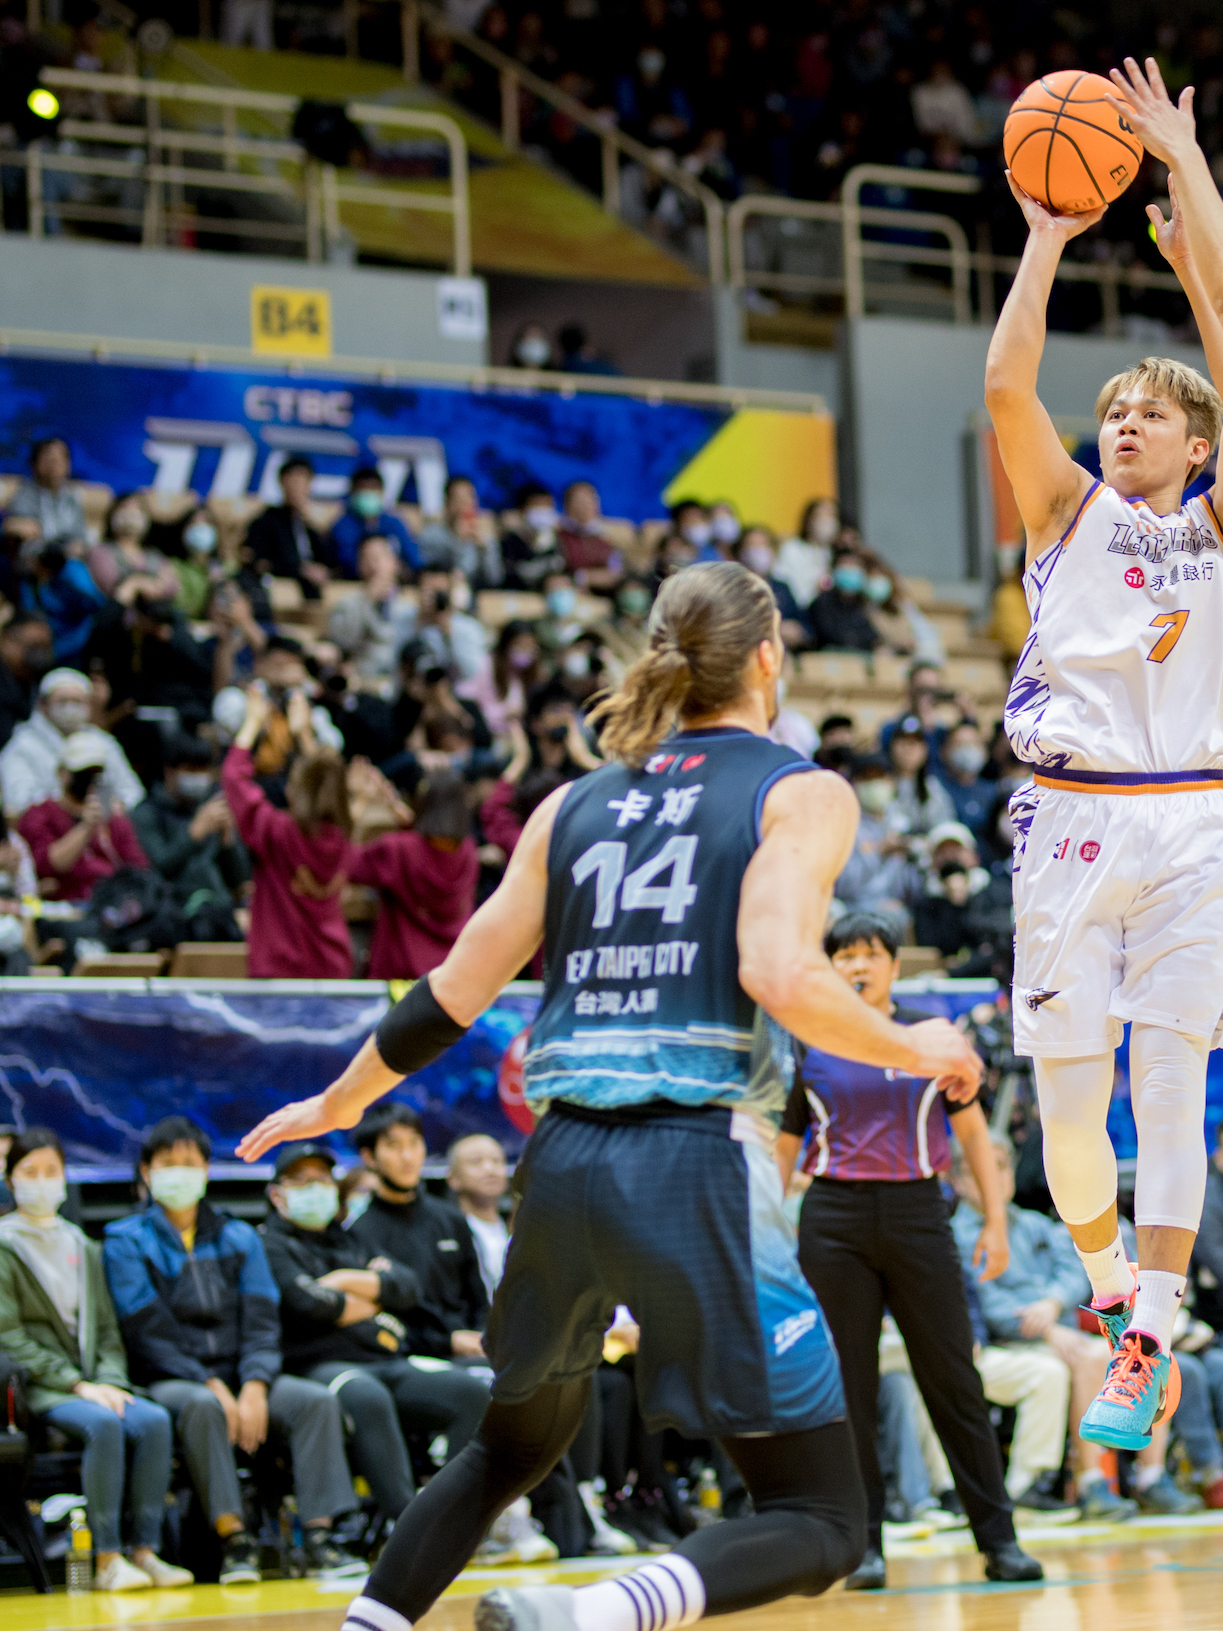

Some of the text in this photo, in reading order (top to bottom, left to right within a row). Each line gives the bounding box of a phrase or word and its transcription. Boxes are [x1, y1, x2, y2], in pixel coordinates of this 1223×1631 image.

[261, 296, 321, 338] B4
[1146, 609, 1191, 664] 7
[606, 783, 704, 828] 卡斯
[571, 833, 699, 929] 14
